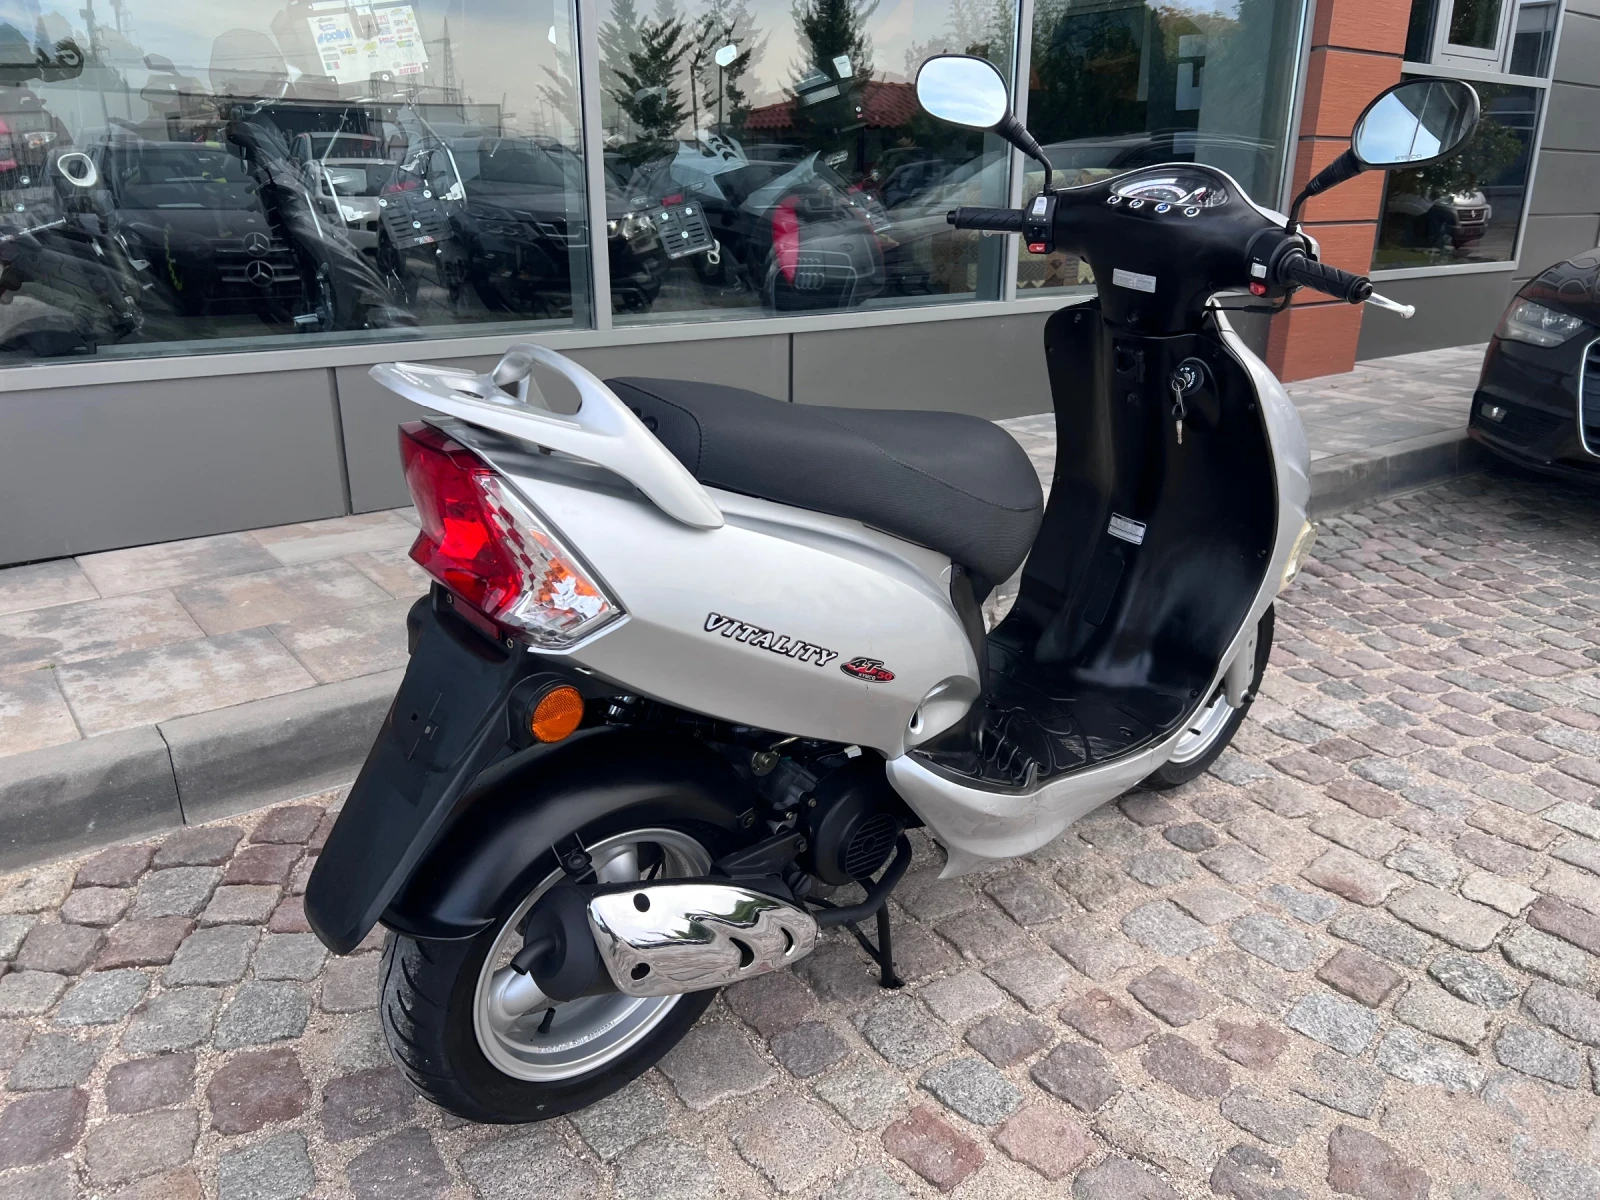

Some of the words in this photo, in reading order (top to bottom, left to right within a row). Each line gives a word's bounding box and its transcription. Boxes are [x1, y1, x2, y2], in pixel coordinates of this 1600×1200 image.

[704, 612, 838, 667] VITALITY
[849, 658, 884, 673] 4T
[877, 671, 893, 681] 50
